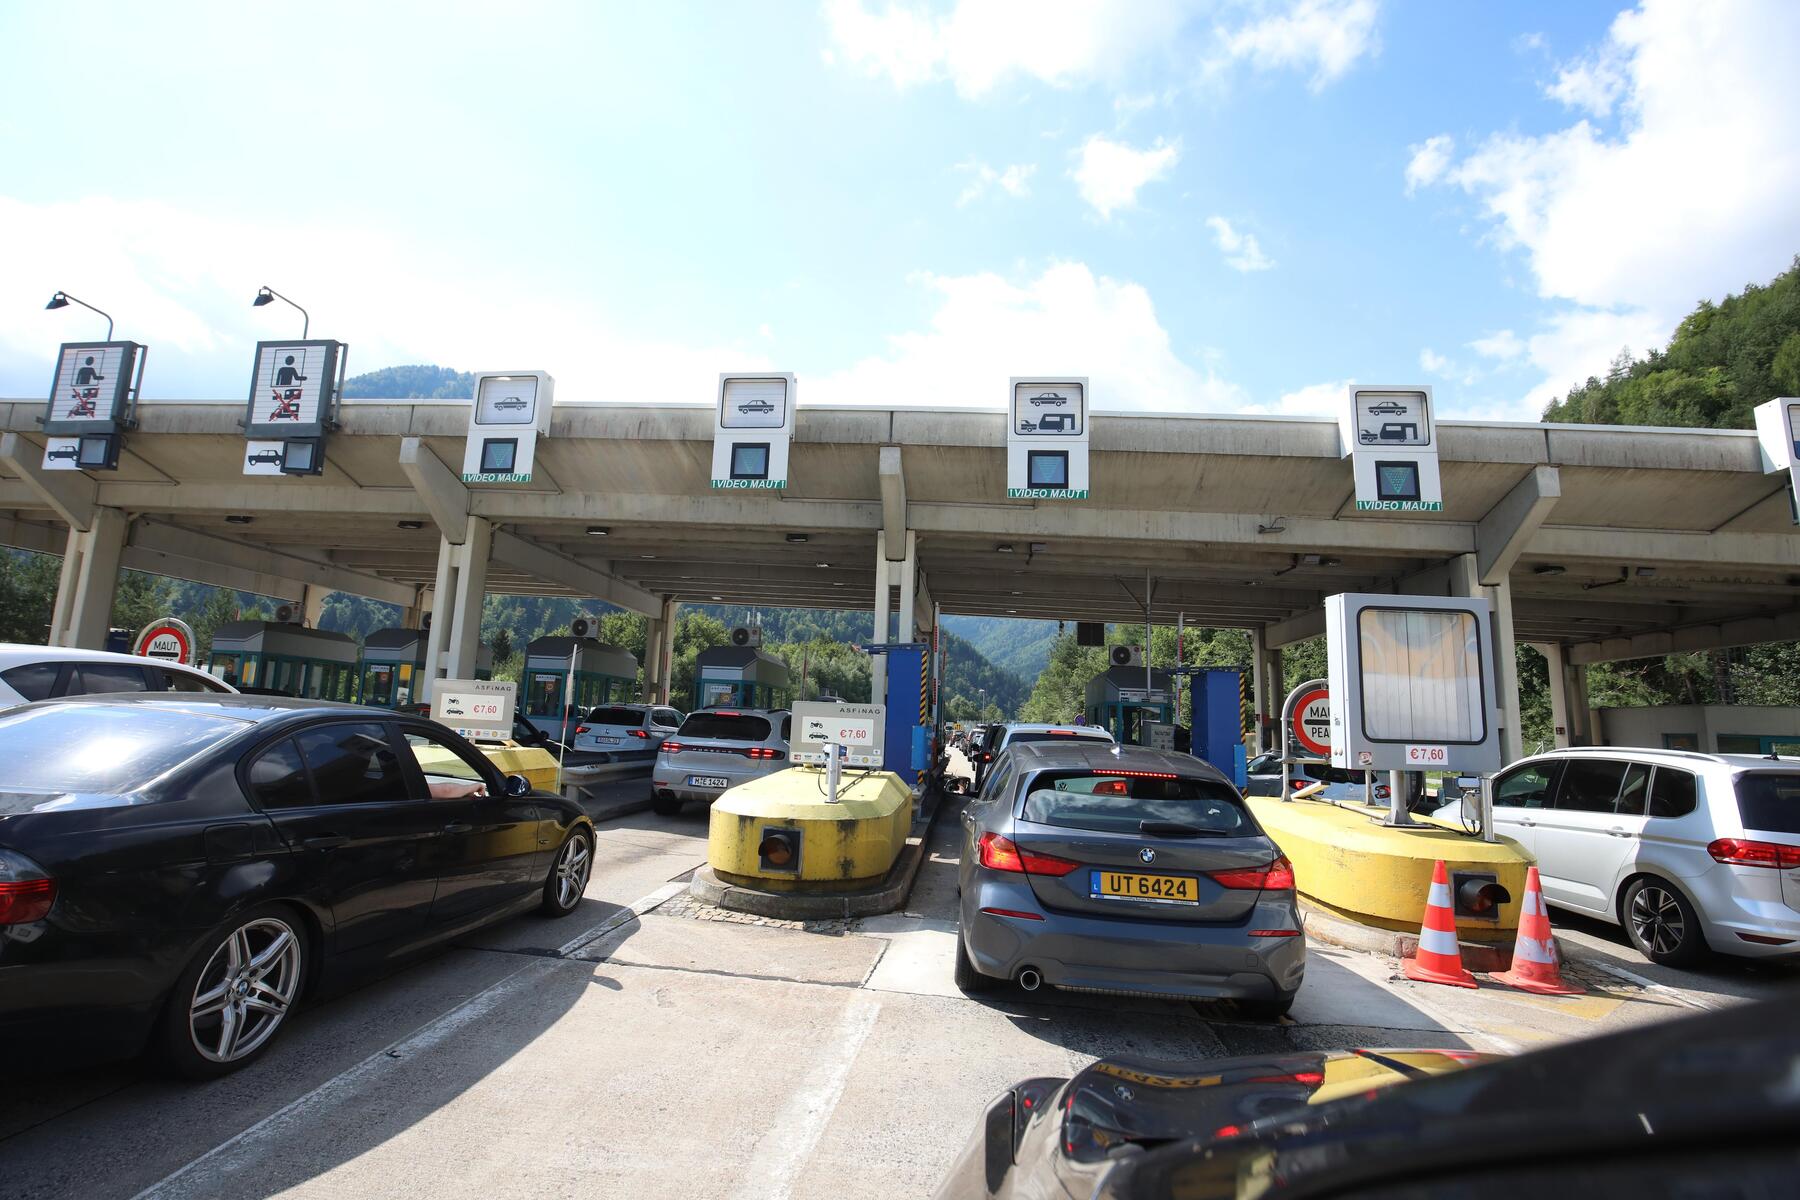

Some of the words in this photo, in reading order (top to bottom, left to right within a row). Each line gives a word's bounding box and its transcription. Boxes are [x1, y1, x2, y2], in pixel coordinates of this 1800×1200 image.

[468, 473, 495, 482] VIDEO
[497, 473, 526, 482] MAUT
[717, 479, 748, 489] VIDEO
[750, 479, 780, 489] MAUT
[1014, 489, 1048, 498] VIDEO
[1050, 489, 1082, 499] MAUT
[1364, 501, 1399, 510] VIDEO
[1401, 501, 1435, 511] MAUT
[153, 641, 178, 651] MAUT
[1310, 706, 1330, 718] MA
[1311, 727, 1330, 738] PEA
[1093, 883, 1099, 891] L
[1110, 875, 1133, 893] UT
[1139, 877, 1187, 897] 6424
